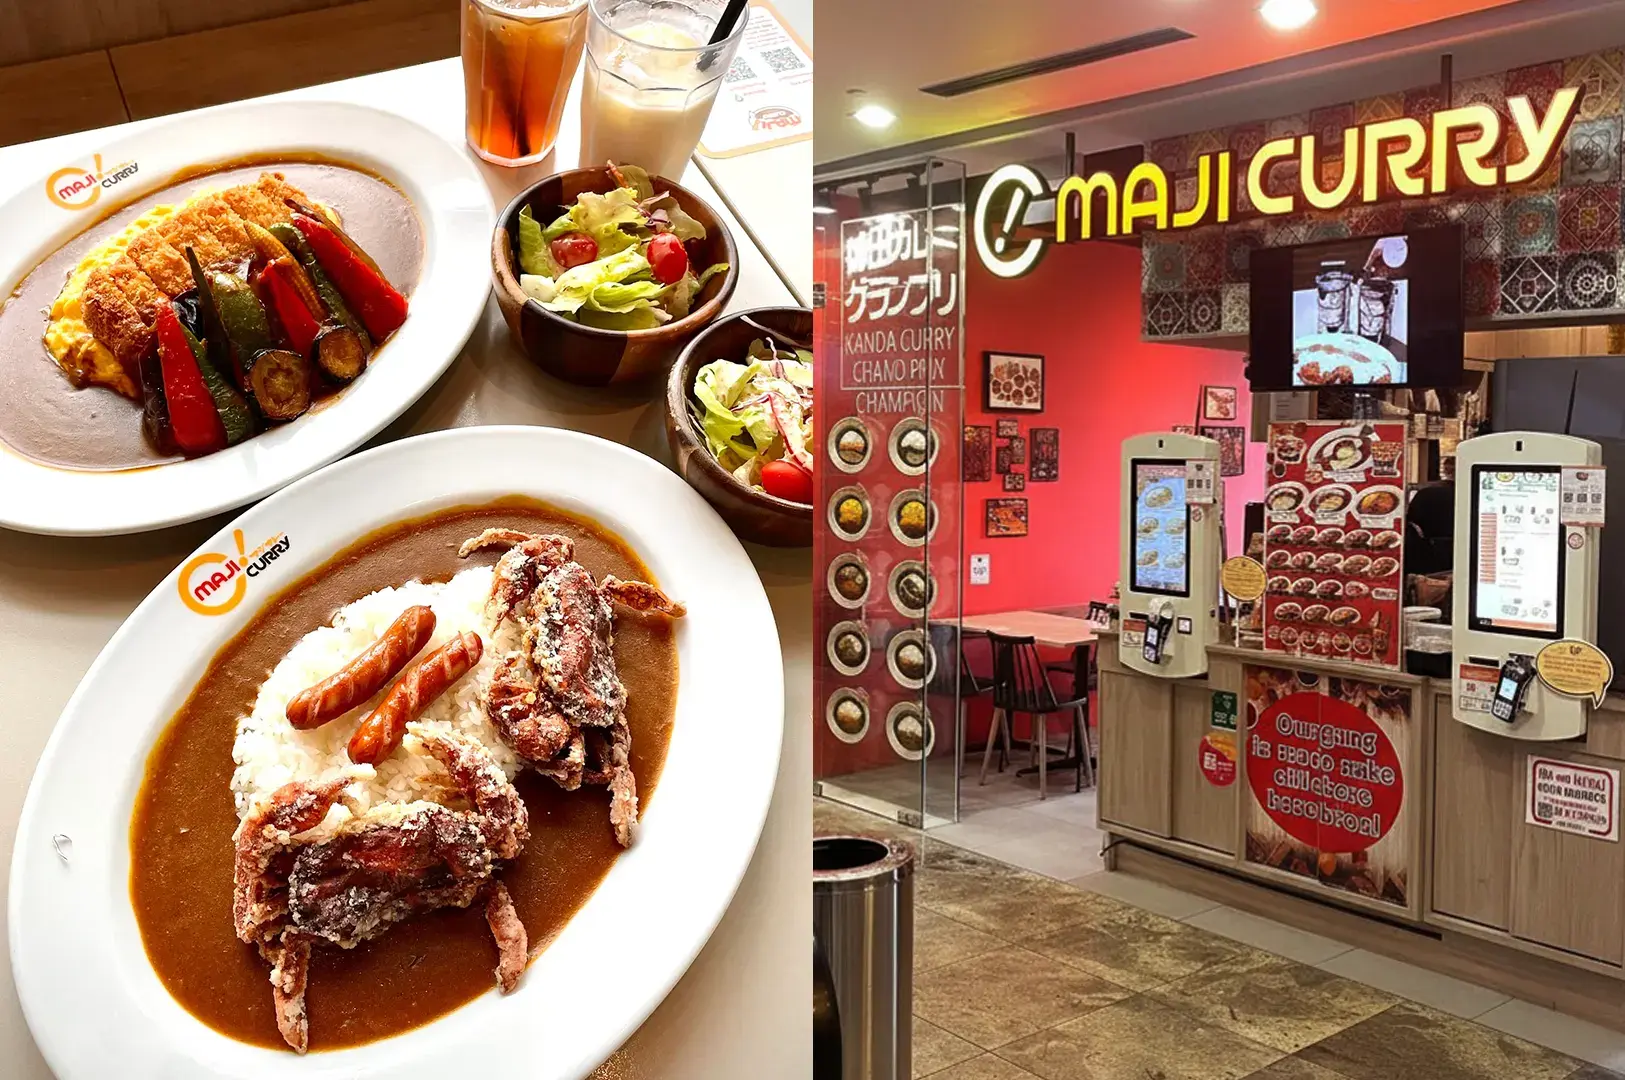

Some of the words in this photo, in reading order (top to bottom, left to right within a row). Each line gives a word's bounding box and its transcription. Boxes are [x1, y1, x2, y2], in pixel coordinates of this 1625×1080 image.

[101, 162, 139, 188] CURRY
[1056, 151, 1230, 243] MAJI
[1247, 84, 1585, 214] CURRY
[58, 174, 98, 200] MAJI
[844, 330, 897, 355] KANDA
[900, 326, 956, 352] CURRY
[246, 535, 290, 578] CURRY
[194, 559, 241, 602] MAJI
